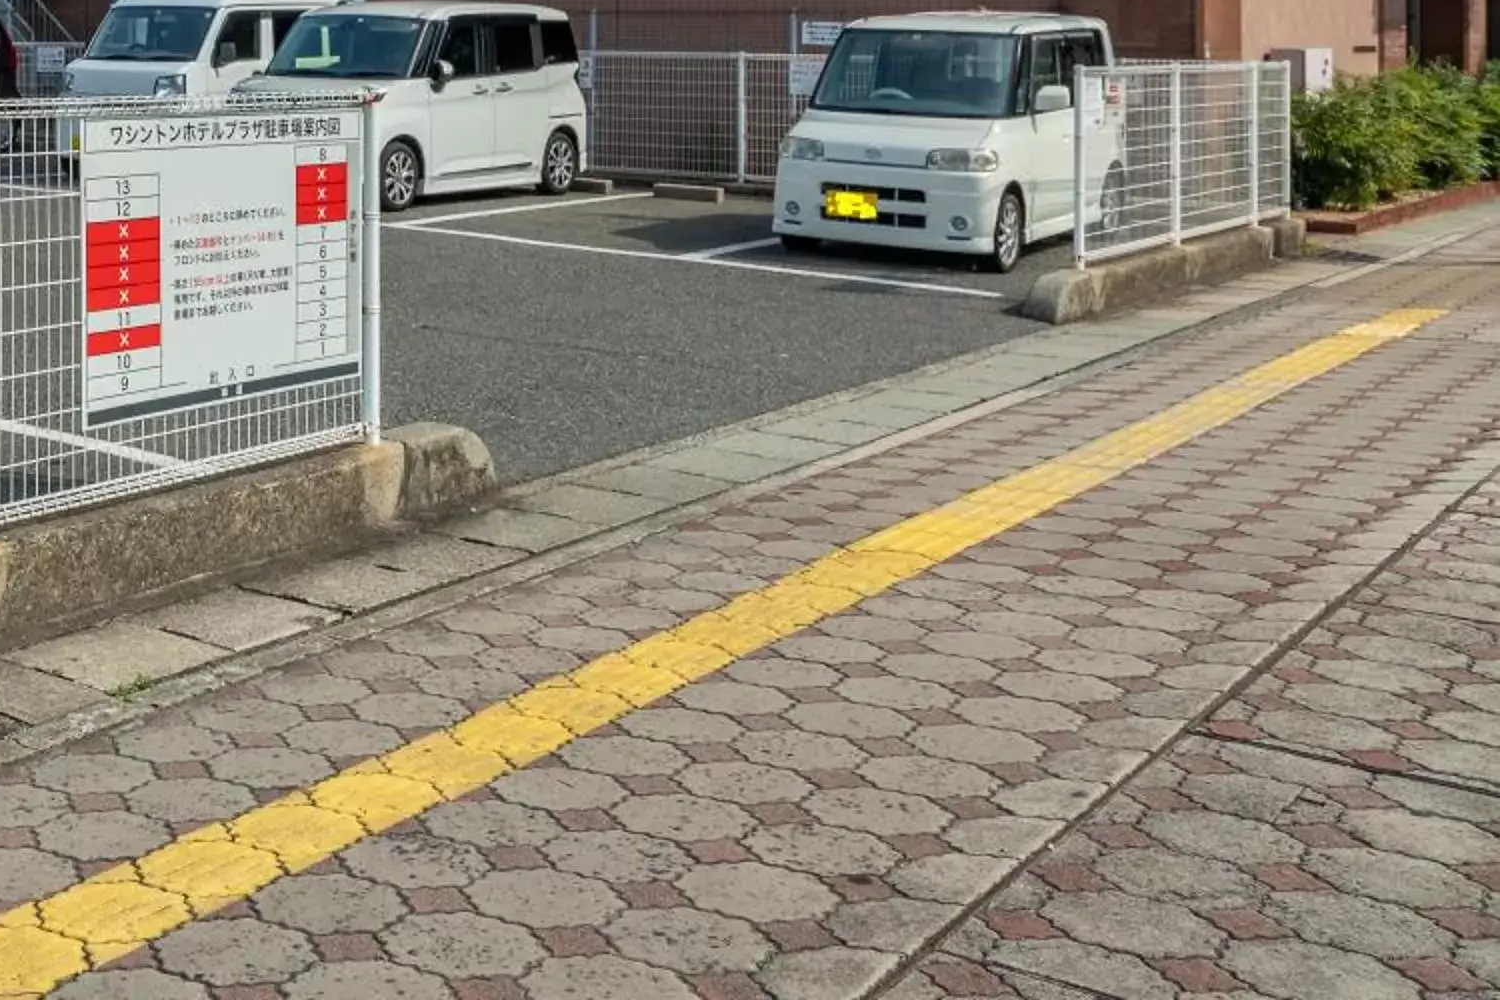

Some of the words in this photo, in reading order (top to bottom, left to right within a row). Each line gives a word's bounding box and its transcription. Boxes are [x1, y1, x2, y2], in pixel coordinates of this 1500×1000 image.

[110, 117, 341, 145] ワシントンホテルプラザ駐車場案内図
[319, 149, 327, 160] 8
[115, 180, 131, 195] 13
[115, 202, 131, 216] 12
[320, 227, 327, 240] 7
[319, 246, 327, 259] 6
[319, 266, 327, 278] 5
[319, 285, 327, 297] 4
[319, 304, 327, 317] 3
[117, 312, 130, 326] 11
[319, 324, 327, 337] 2
[320, 342, 325, 355] 1
[117, 355, 131, 369] 10
[121, 377, 129, 390] 9
